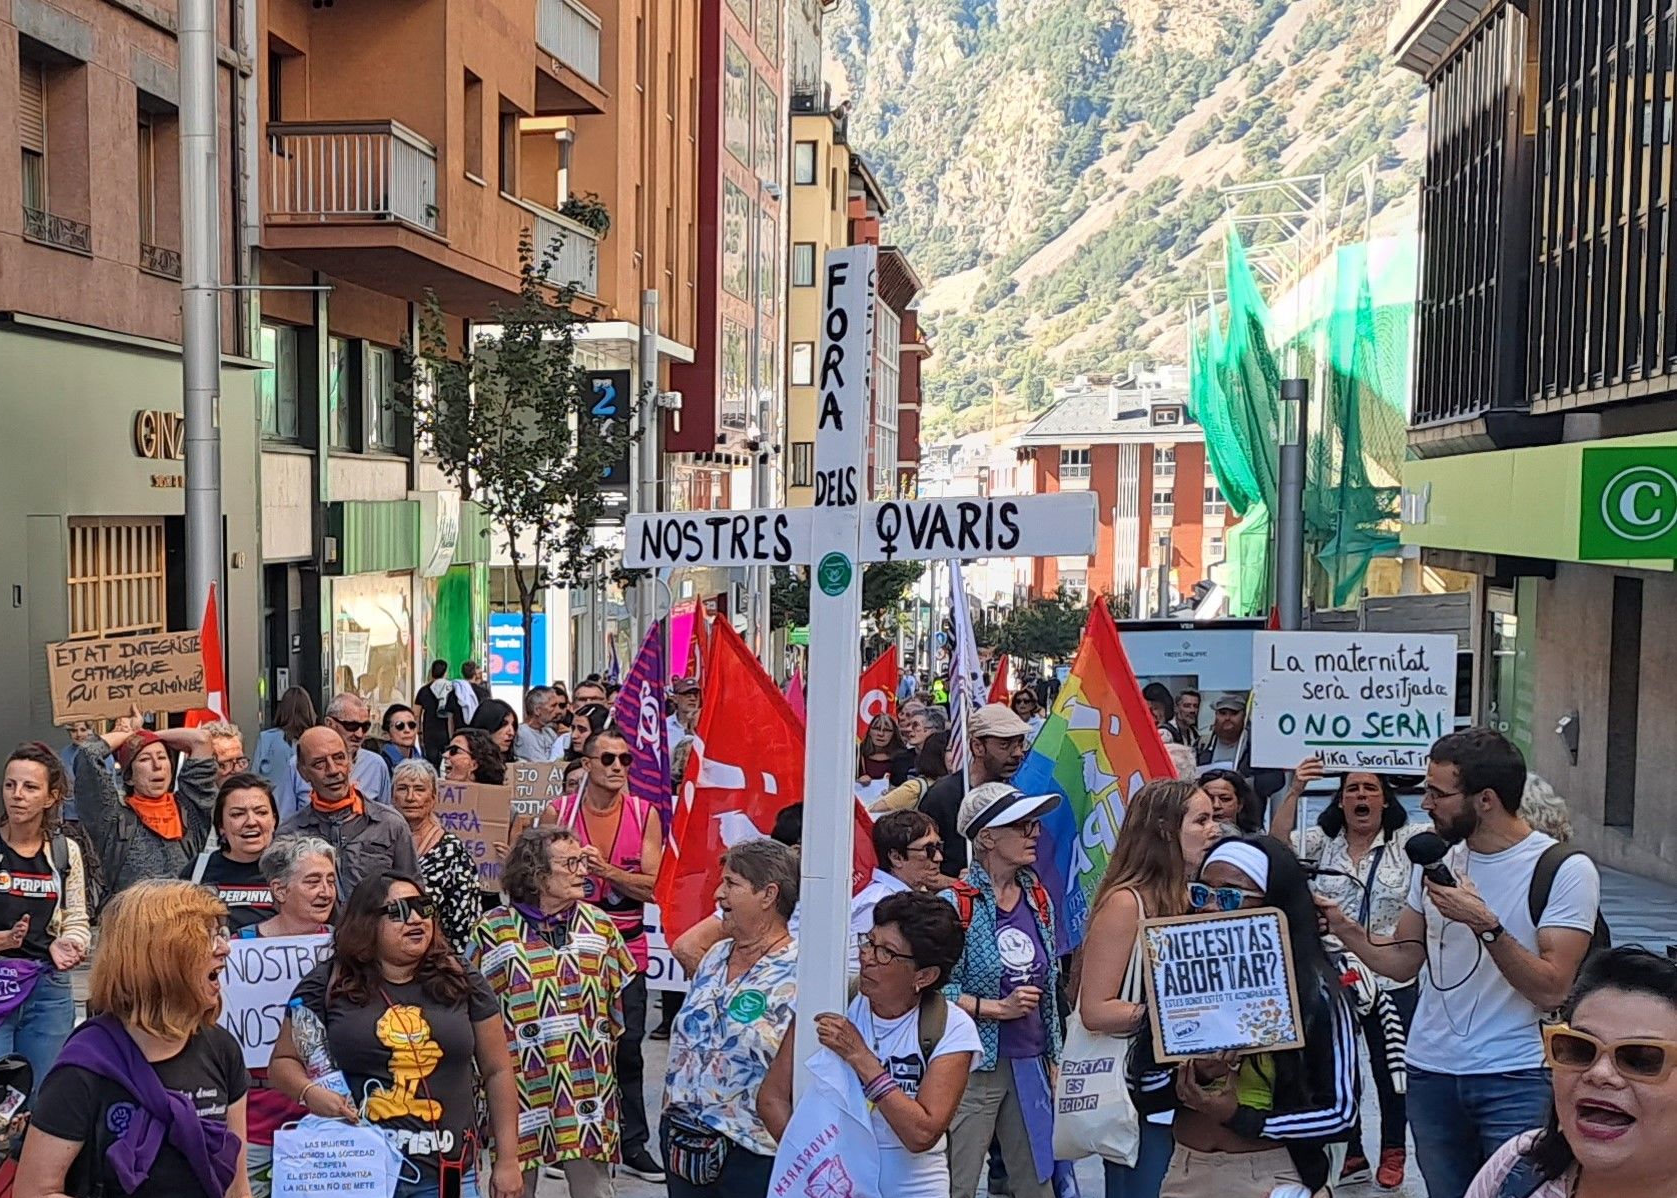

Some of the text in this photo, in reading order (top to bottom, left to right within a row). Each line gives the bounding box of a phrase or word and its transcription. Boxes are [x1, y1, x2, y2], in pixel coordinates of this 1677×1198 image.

[818, 261, 849, 431] FORA
[134, 409, 184, 460] GINZ
[815, 466, 857, 508] DELS
[640, 513, 793, 563] NOSTRES
[1271, 642, 1430, 673] La maternitat
[107, 684, 134, 700] EST
[1301, 675, 1448, 708] serà desitjada
[1278, 713, 1296, 735] O
[1305, 712, 1352, 738] NO
[1164, 951, 1277, 997] ABORTAR?
[384, 1127, 454, 1155] RFIELD
[326, 1183, 340, 1191] NO
